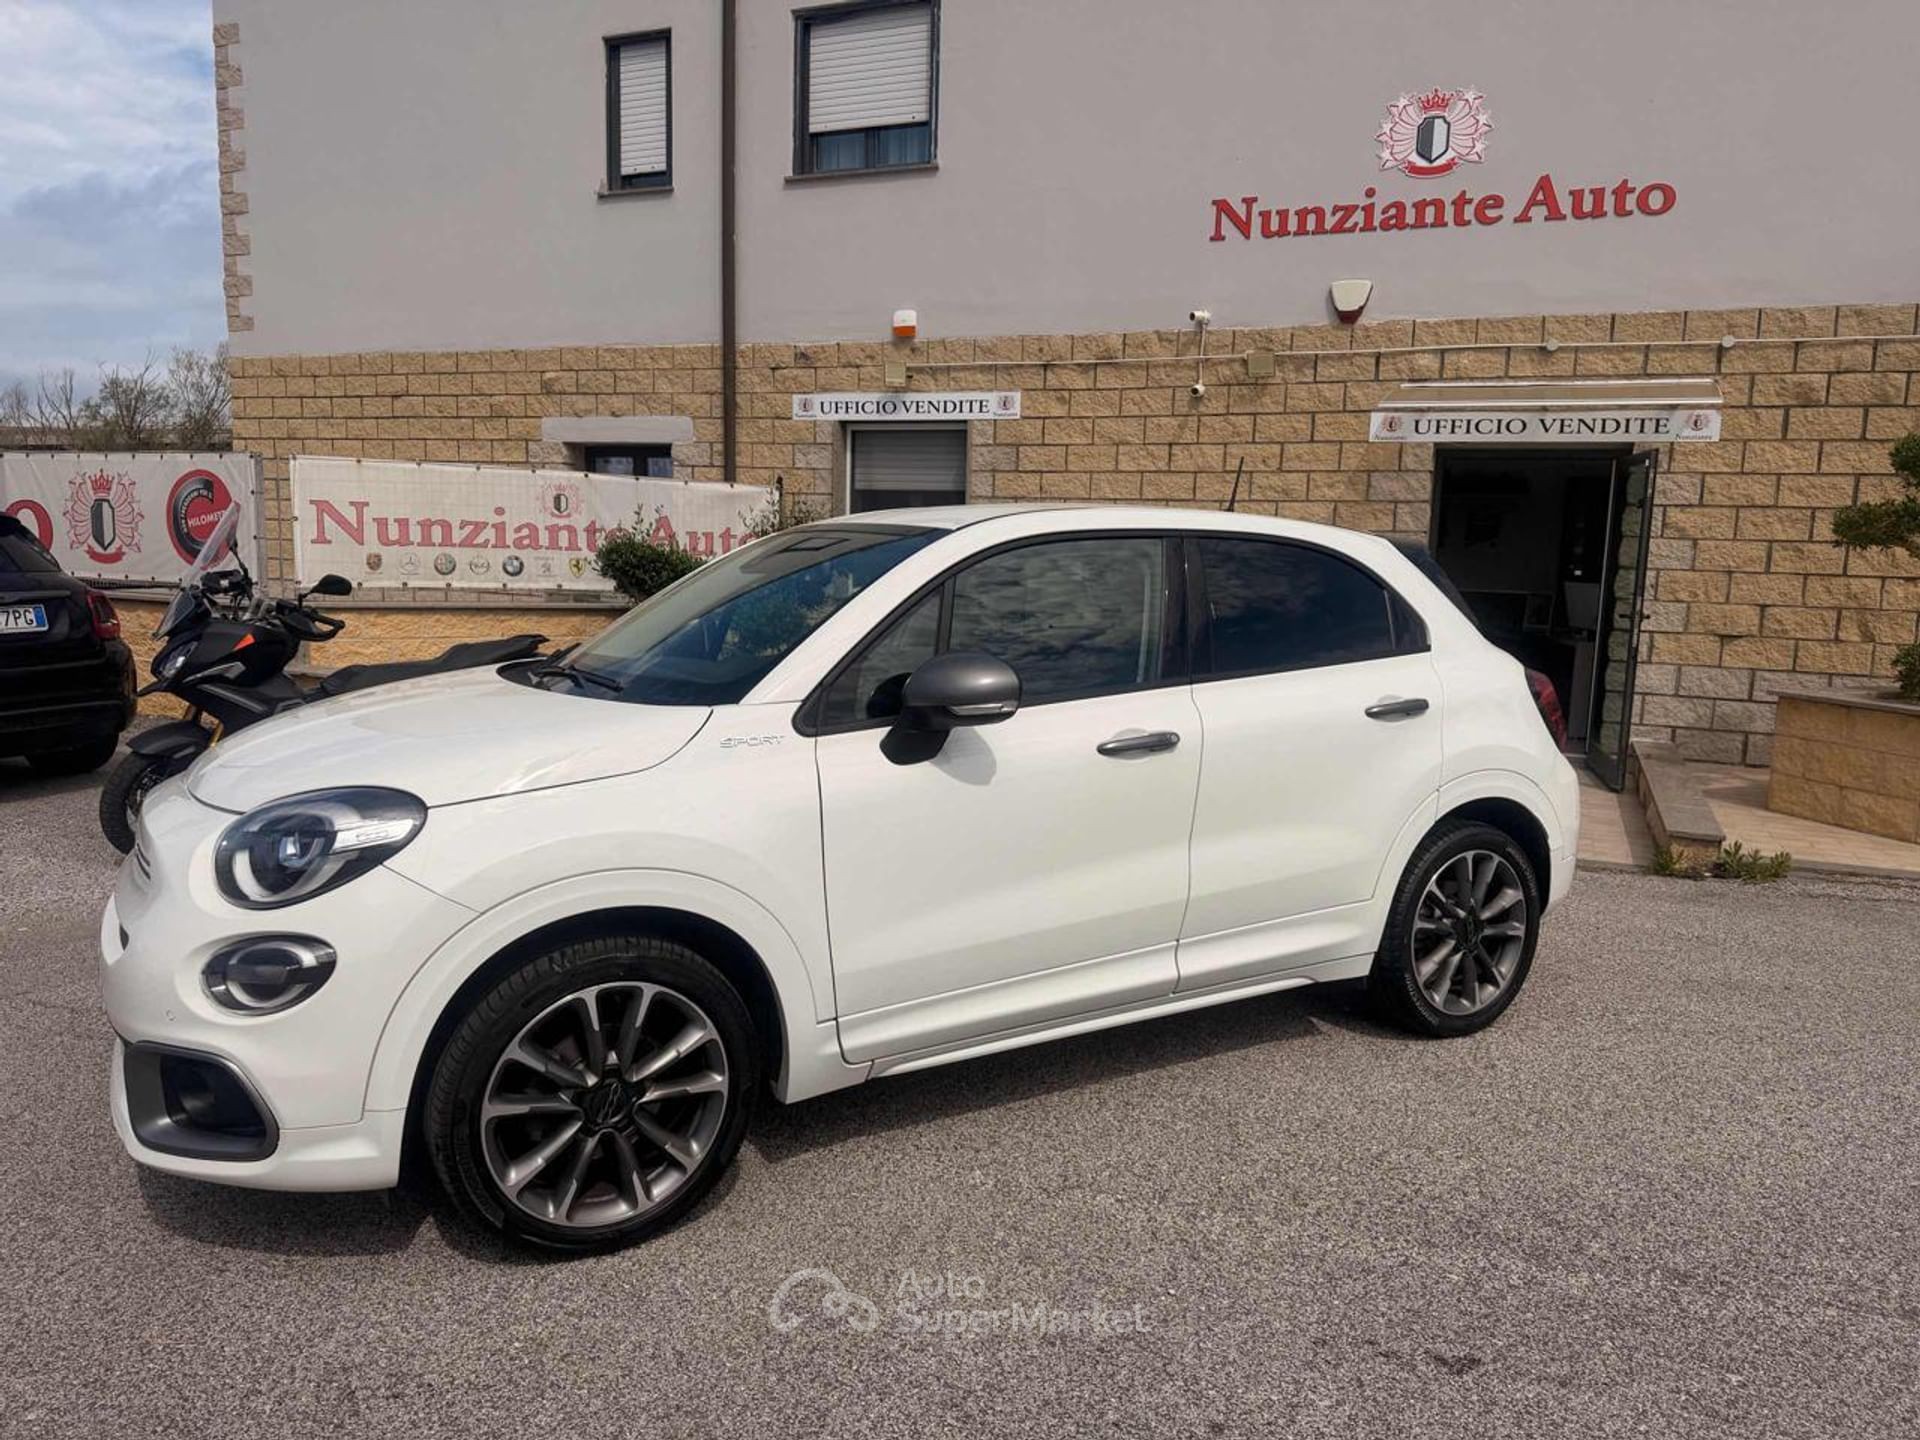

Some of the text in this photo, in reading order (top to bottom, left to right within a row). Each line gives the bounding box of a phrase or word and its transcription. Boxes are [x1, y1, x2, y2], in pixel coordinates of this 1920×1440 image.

[1209, 173, 1677, 242] Nunziante Auto
[820, 399, 990, 415] UFFICIO VENDITE
[1413, 417, 1670, 436] UFFICIO VENDITE
[720, 735, 785, 748] SPORT
